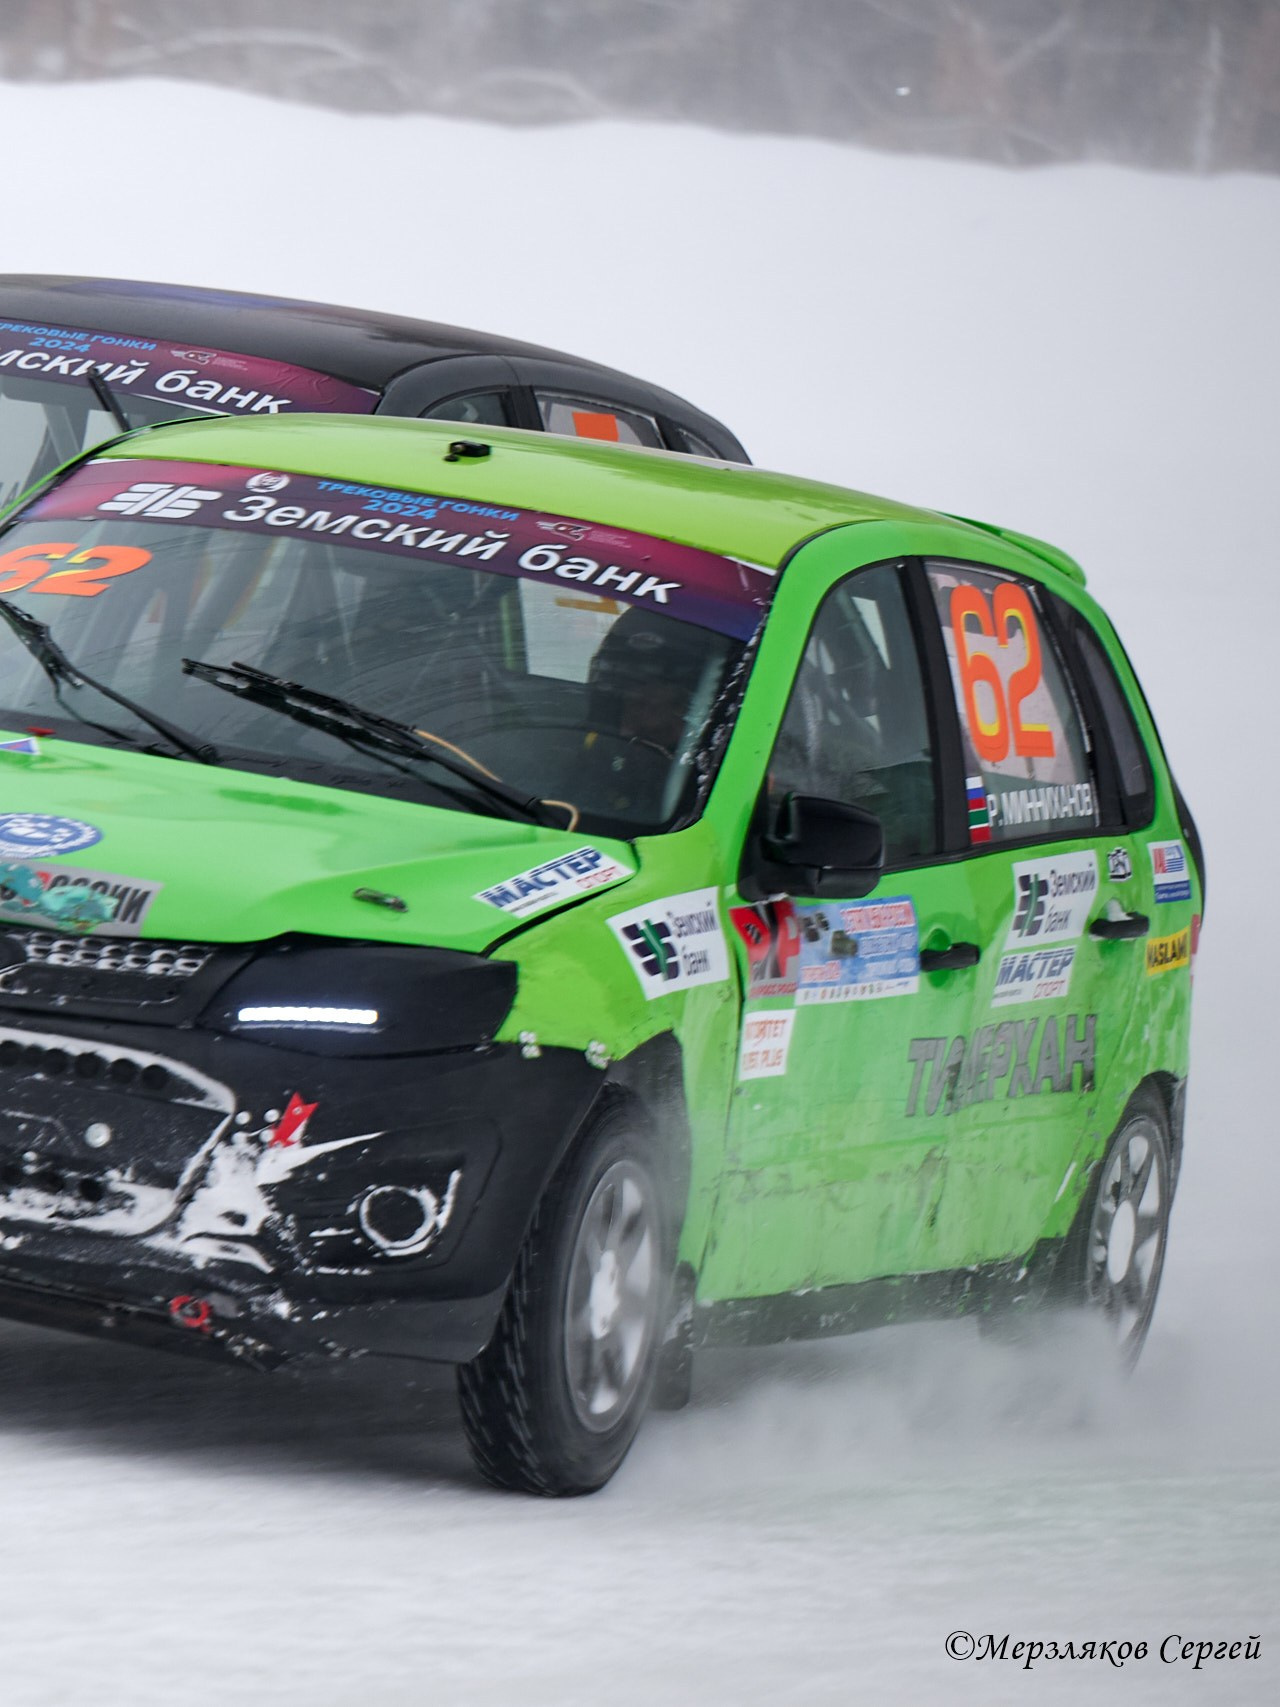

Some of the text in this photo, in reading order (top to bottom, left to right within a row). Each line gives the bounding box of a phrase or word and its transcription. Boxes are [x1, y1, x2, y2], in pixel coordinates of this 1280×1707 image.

[29, 336, 91, 353] 2024
[93, 330, 157, 352] ГОНКИ
[155, 369, 292, 414] банк
[317, 481, 520, 522] ТРЕКОВЫЕ ГОНКИ
[362, 499, 438, 520] 2024
[222, 495, 682, 604] Земский банк
[949, 582, 1056, 763] 62
[478, 848, 603, 908] МАСТЕР
[1049, 862, 1097, 898] Земский
[1044, 904, 1072, 934] банк
[995, 947, 1076, 987] МАСТЕР
